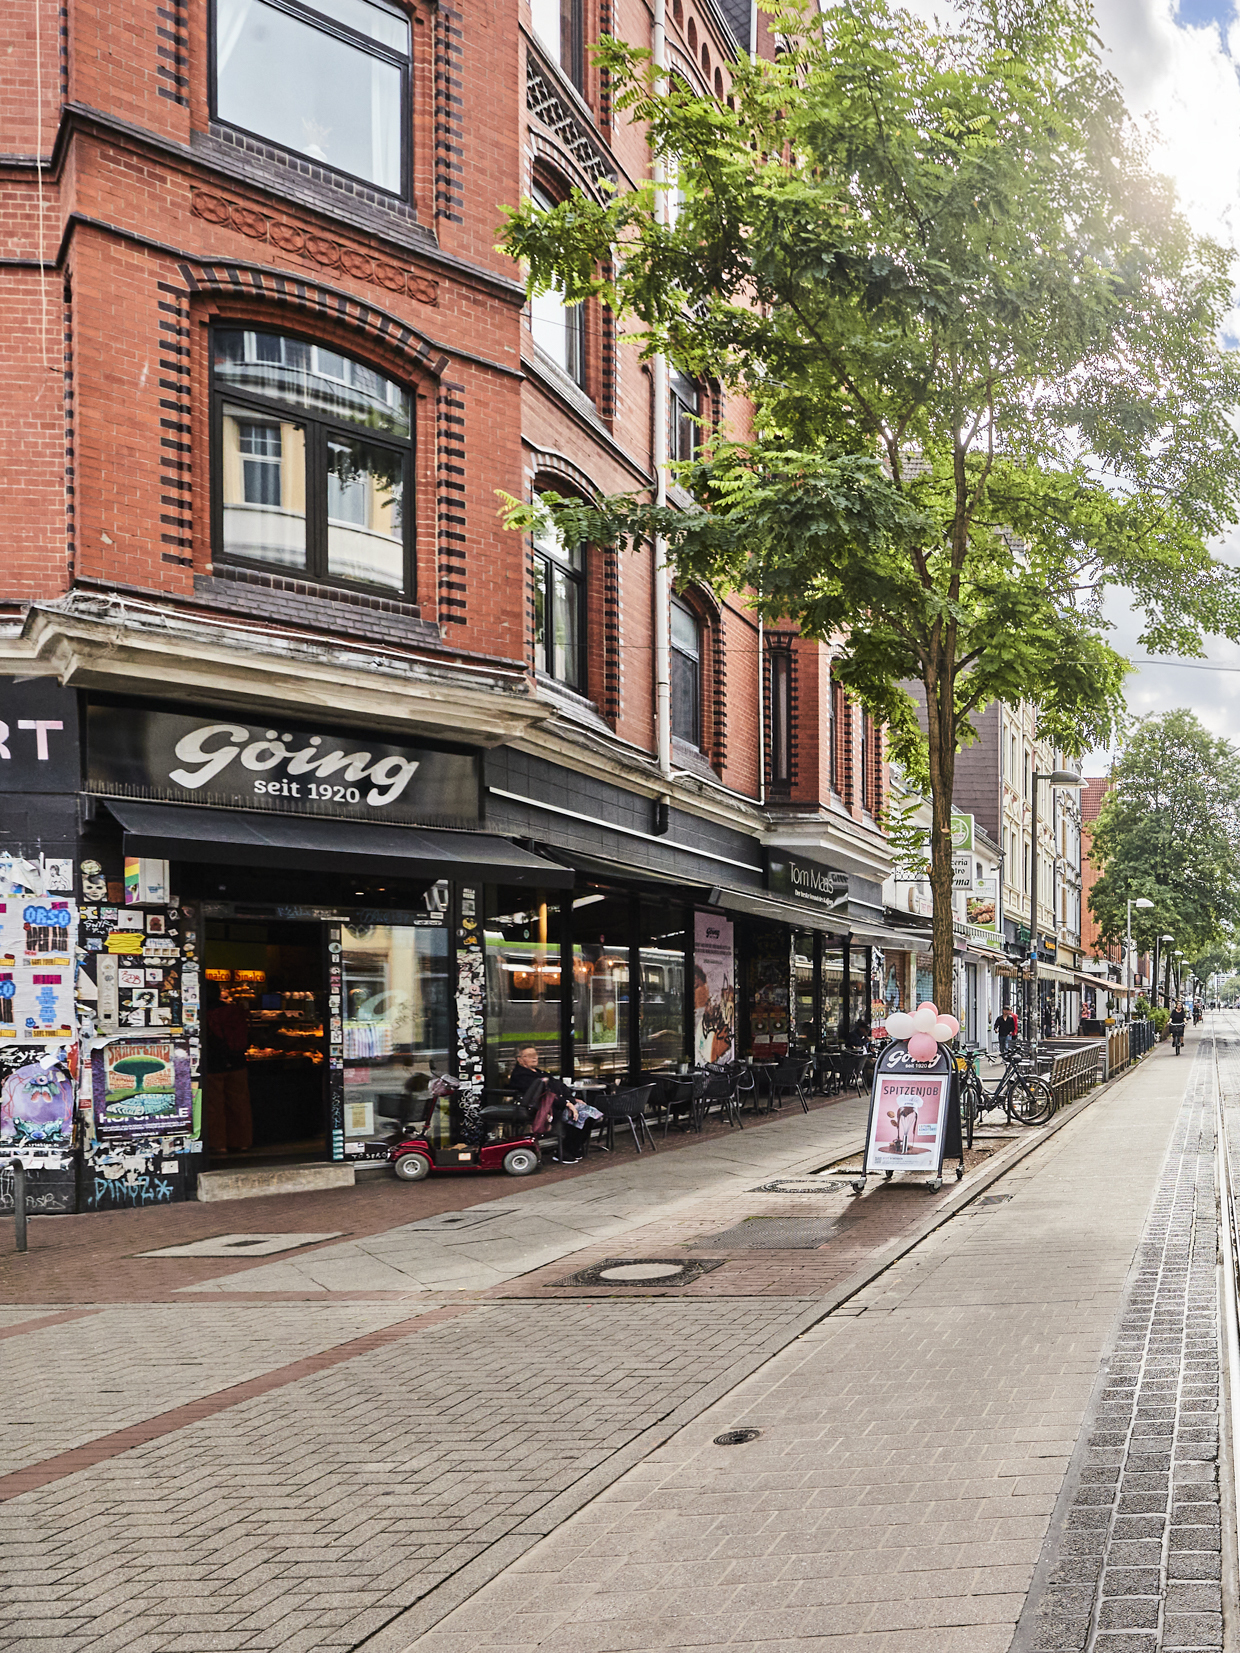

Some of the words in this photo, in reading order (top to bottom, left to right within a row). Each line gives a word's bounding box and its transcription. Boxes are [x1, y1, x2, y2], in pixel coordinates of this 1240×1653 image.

[0, 719, 63, 760] T
[169, 724, 420, 806] Göing
[254, 780, 301, 797] seit
[308, 783, 360, 804] 1920
[789, 861, 809, 886] Tom
[811, 869, 834, 894] Maas
[883, 1086, 939, 1097] SPITZENJOB
